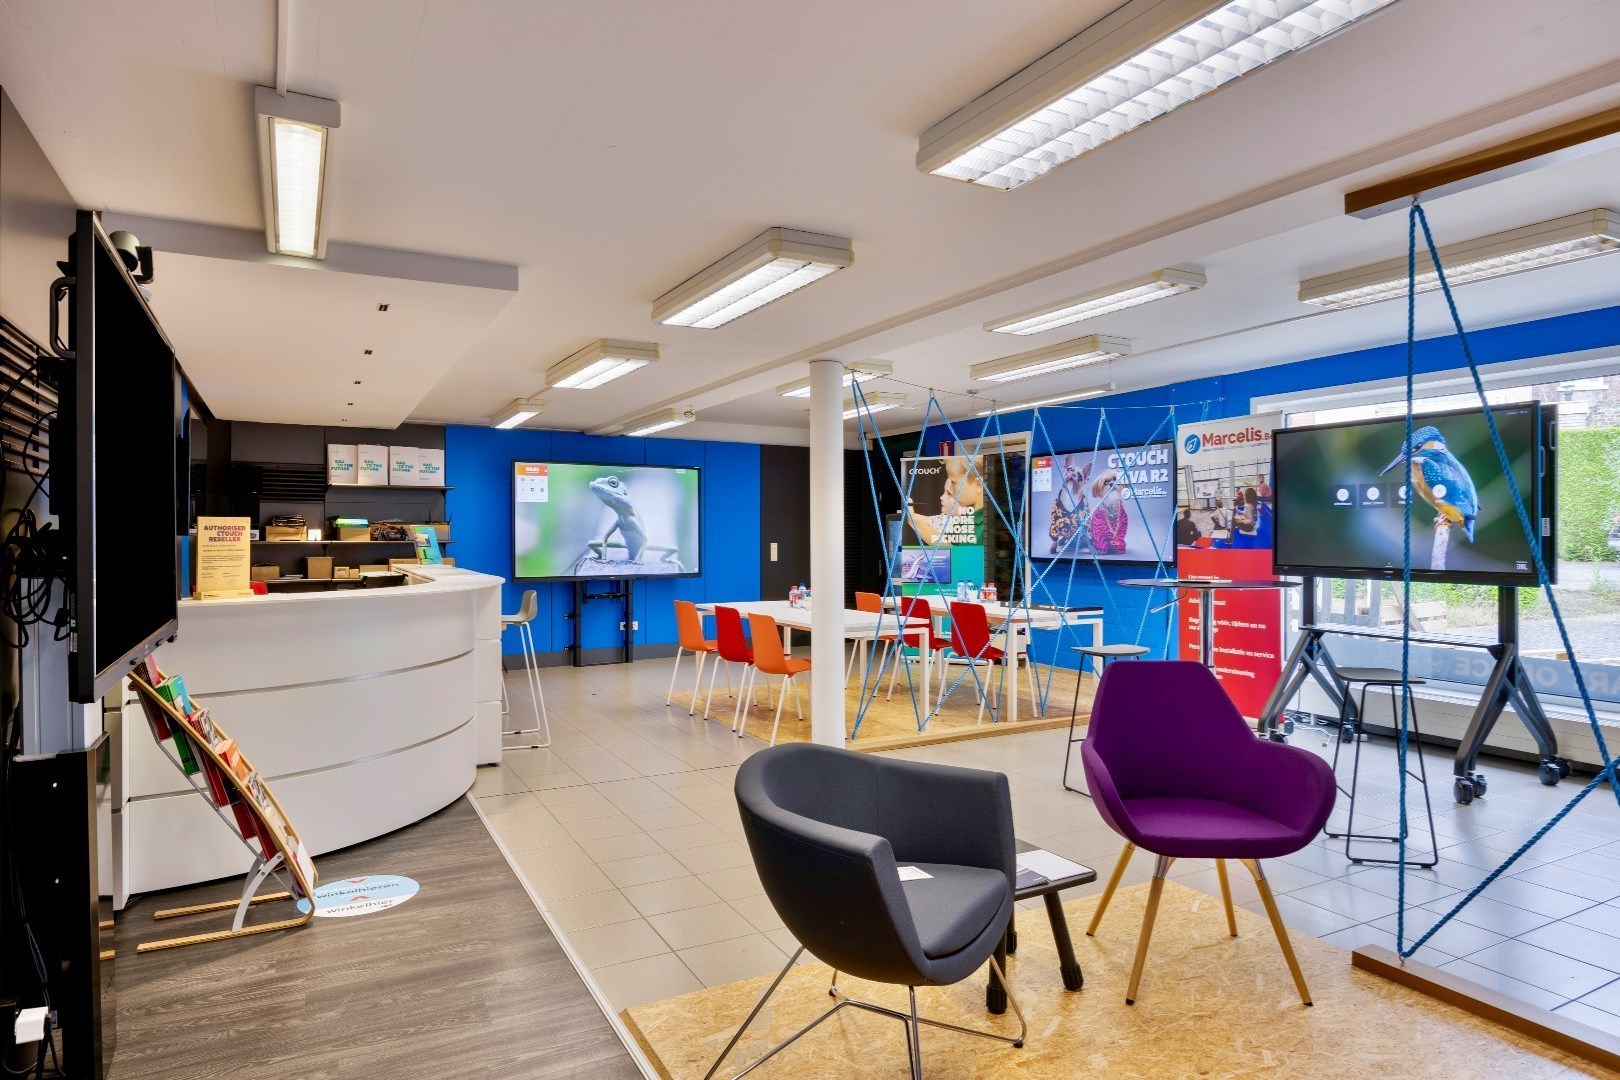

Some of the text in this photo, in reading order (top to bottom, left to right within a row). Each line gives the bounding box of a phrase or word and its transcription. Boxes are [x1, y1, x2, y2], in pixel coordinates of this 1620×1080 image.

[1107, 449, 1168, 469] CTOUCH
[1150, 468, 1169, 483] R2
[958, 506, 975, 515] NO
